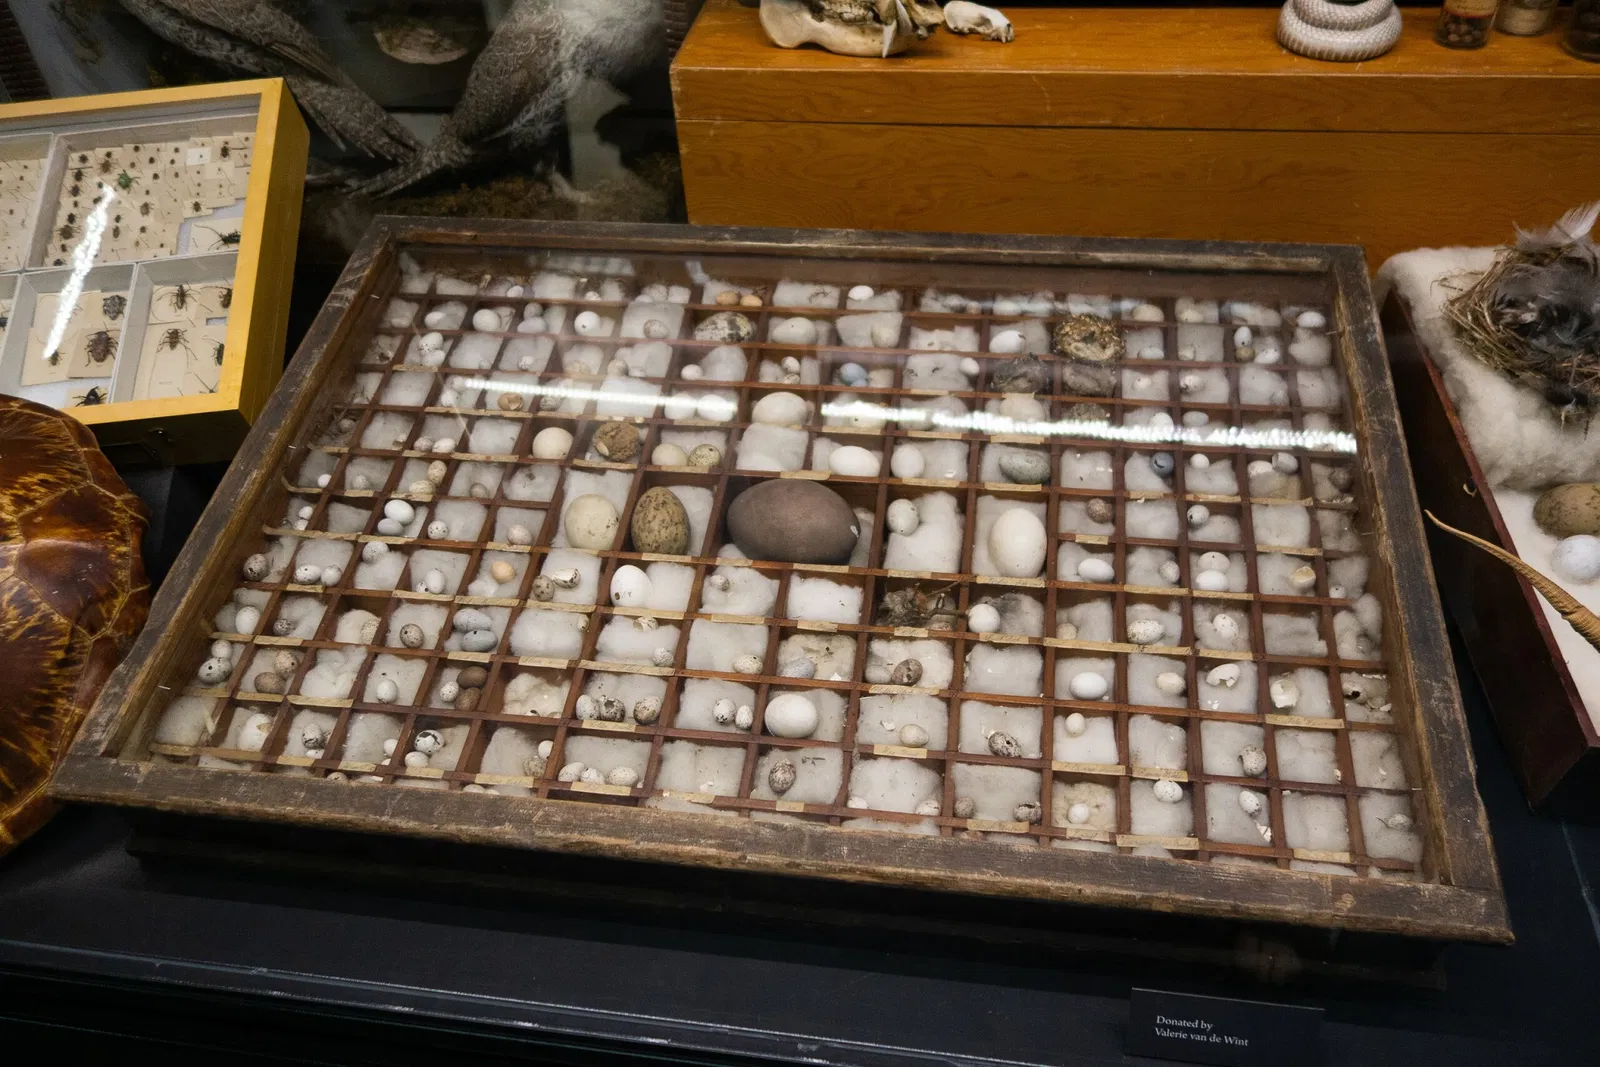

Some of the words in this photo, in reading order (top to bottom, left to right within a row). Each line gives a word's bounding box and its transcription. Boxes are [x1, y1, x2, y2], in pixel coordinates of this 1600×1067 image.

[1156, 1015, 1198, 1028] Donated
[1200, 1020, 1213, 1031] by
[1155, 1027, 1188, 1039] Valerie
[1190, 1034, 1207, 1042] van
[1209, 1034, 1222, 1043] de
[1223, 1035, 1249, 1046] Wint
